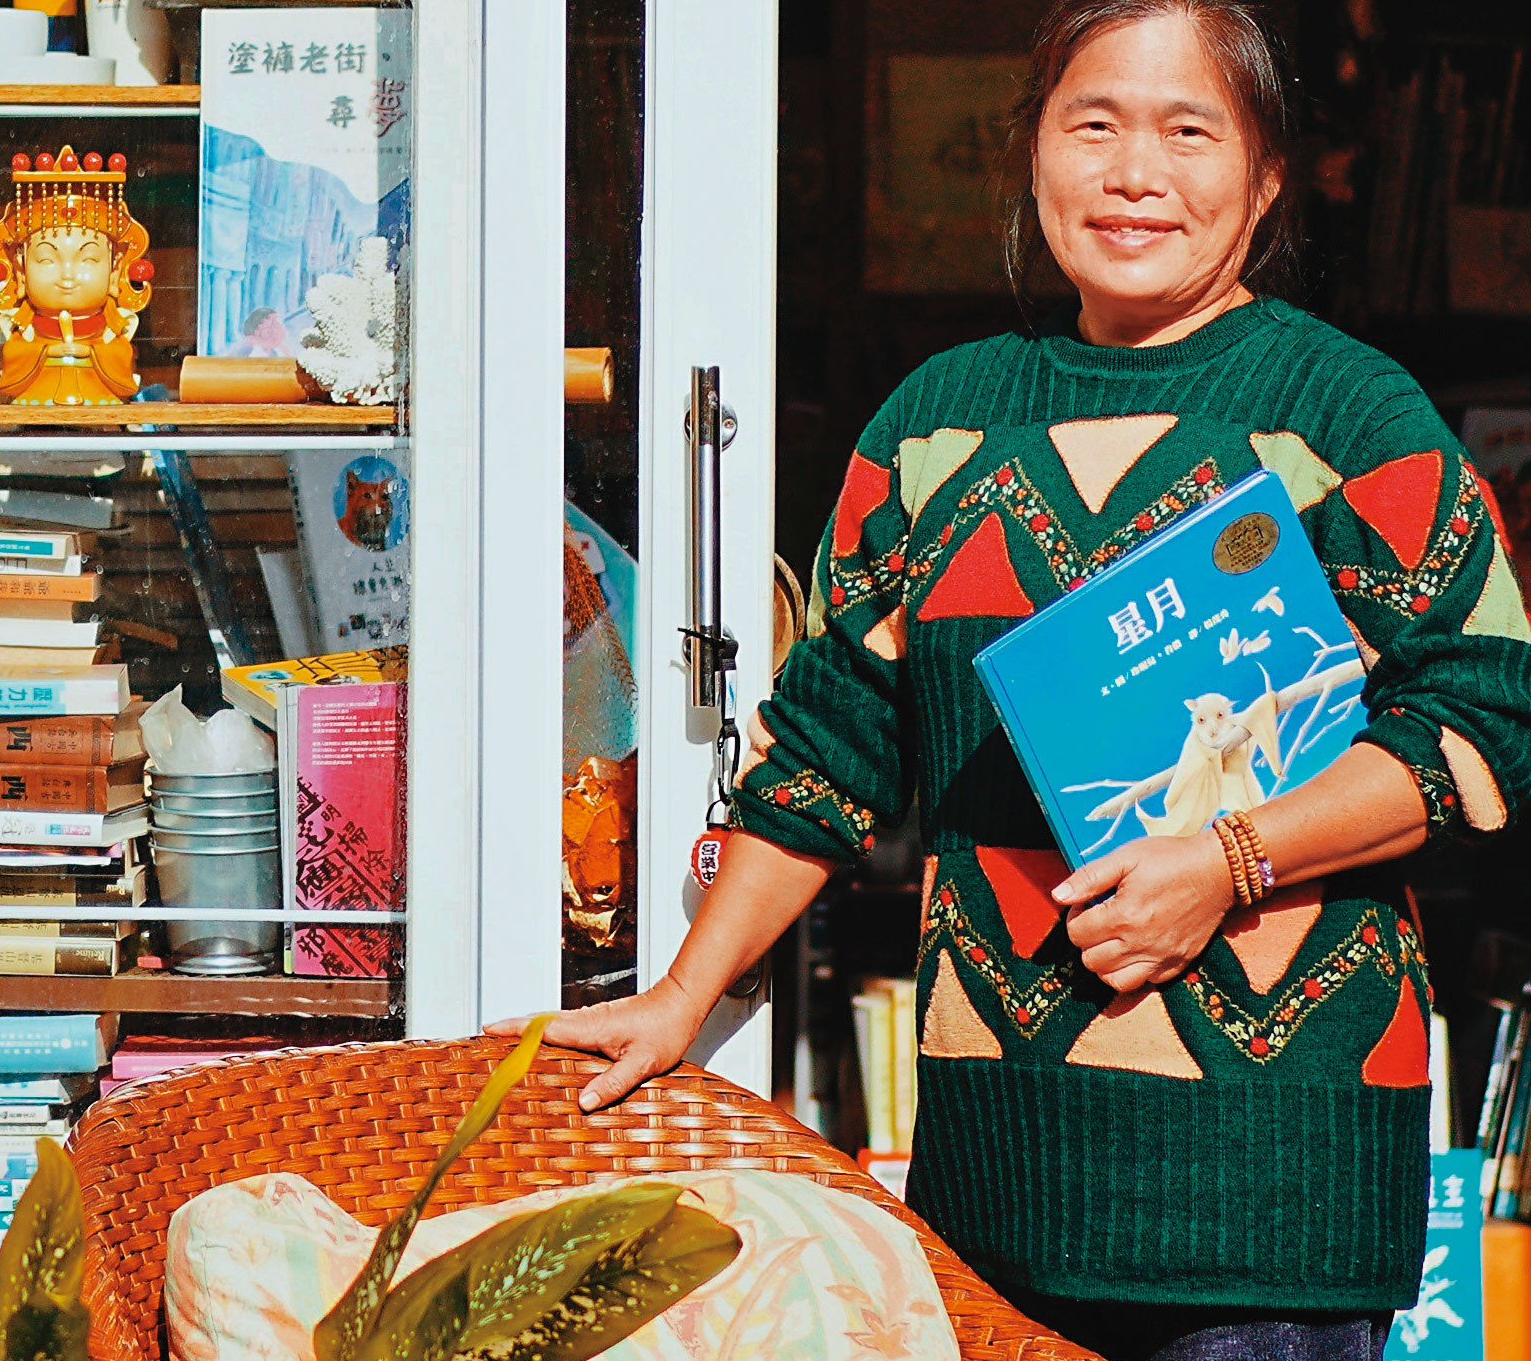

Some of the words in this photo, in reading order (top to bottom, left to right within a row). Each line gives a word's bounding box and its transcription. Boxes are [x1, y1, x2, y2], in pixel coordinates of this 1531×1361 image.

[1107, 576, 1188, 656] 星月
[701, 842, 718, 882] 営業中
